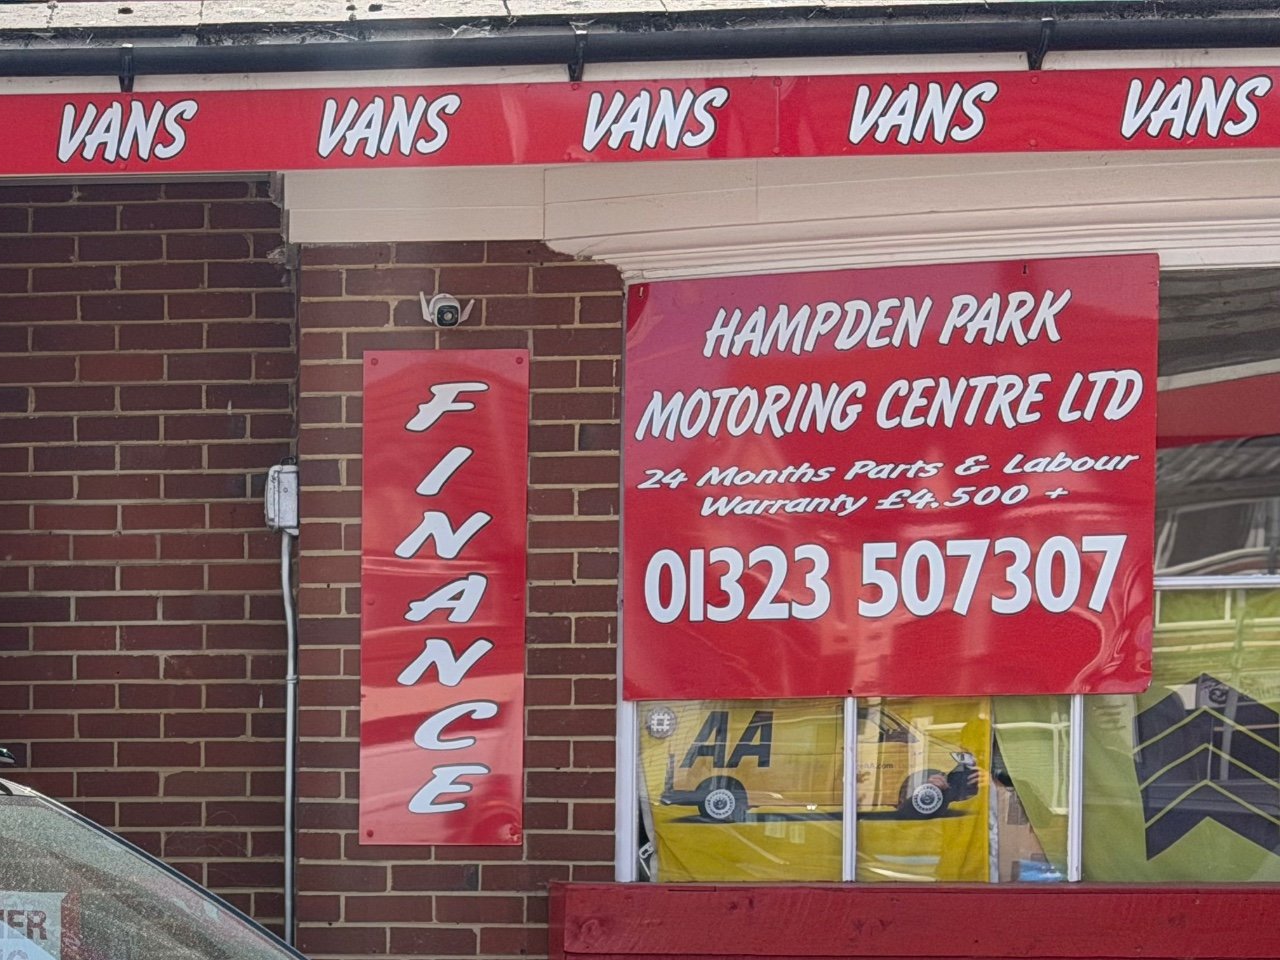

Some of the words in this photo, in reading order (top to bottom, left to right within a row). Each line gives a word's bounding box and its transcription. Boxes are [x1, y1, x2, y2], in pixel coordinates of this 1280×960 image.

[56, 98, 199, 163] VANS
[317, 92, 462, 159] VANS
[582, 86, 730, 153] VANS
[848, 79, 999, 146] VANS
[1120, 74, 1273, 140] VANS
[703, 296, 931, 358] HAMPDEN
[938, 288, 1072, 346] PARK
[634, 380, 867, 441] MOTORING
[875, 372, 1052, 430] CENTRE
[1057, 368, 1144, 423] LTD
[636, 468, 688, 490] 24
[695, 461, 836, 488] Months
[843, 459, 945, 483] Parts
[955, 454, 991, 475] &
[1002, 451, 1140, 475] Labour
[699, 494, 868, 517] Warranty
[1045, 487, 1070, 500] +
[393, 380, 499, 814] FINANCE
[643, 543, 832, 624] 01323
[856, 533, 1128, 618] 507307
[679, 710, 774, 768] AA
